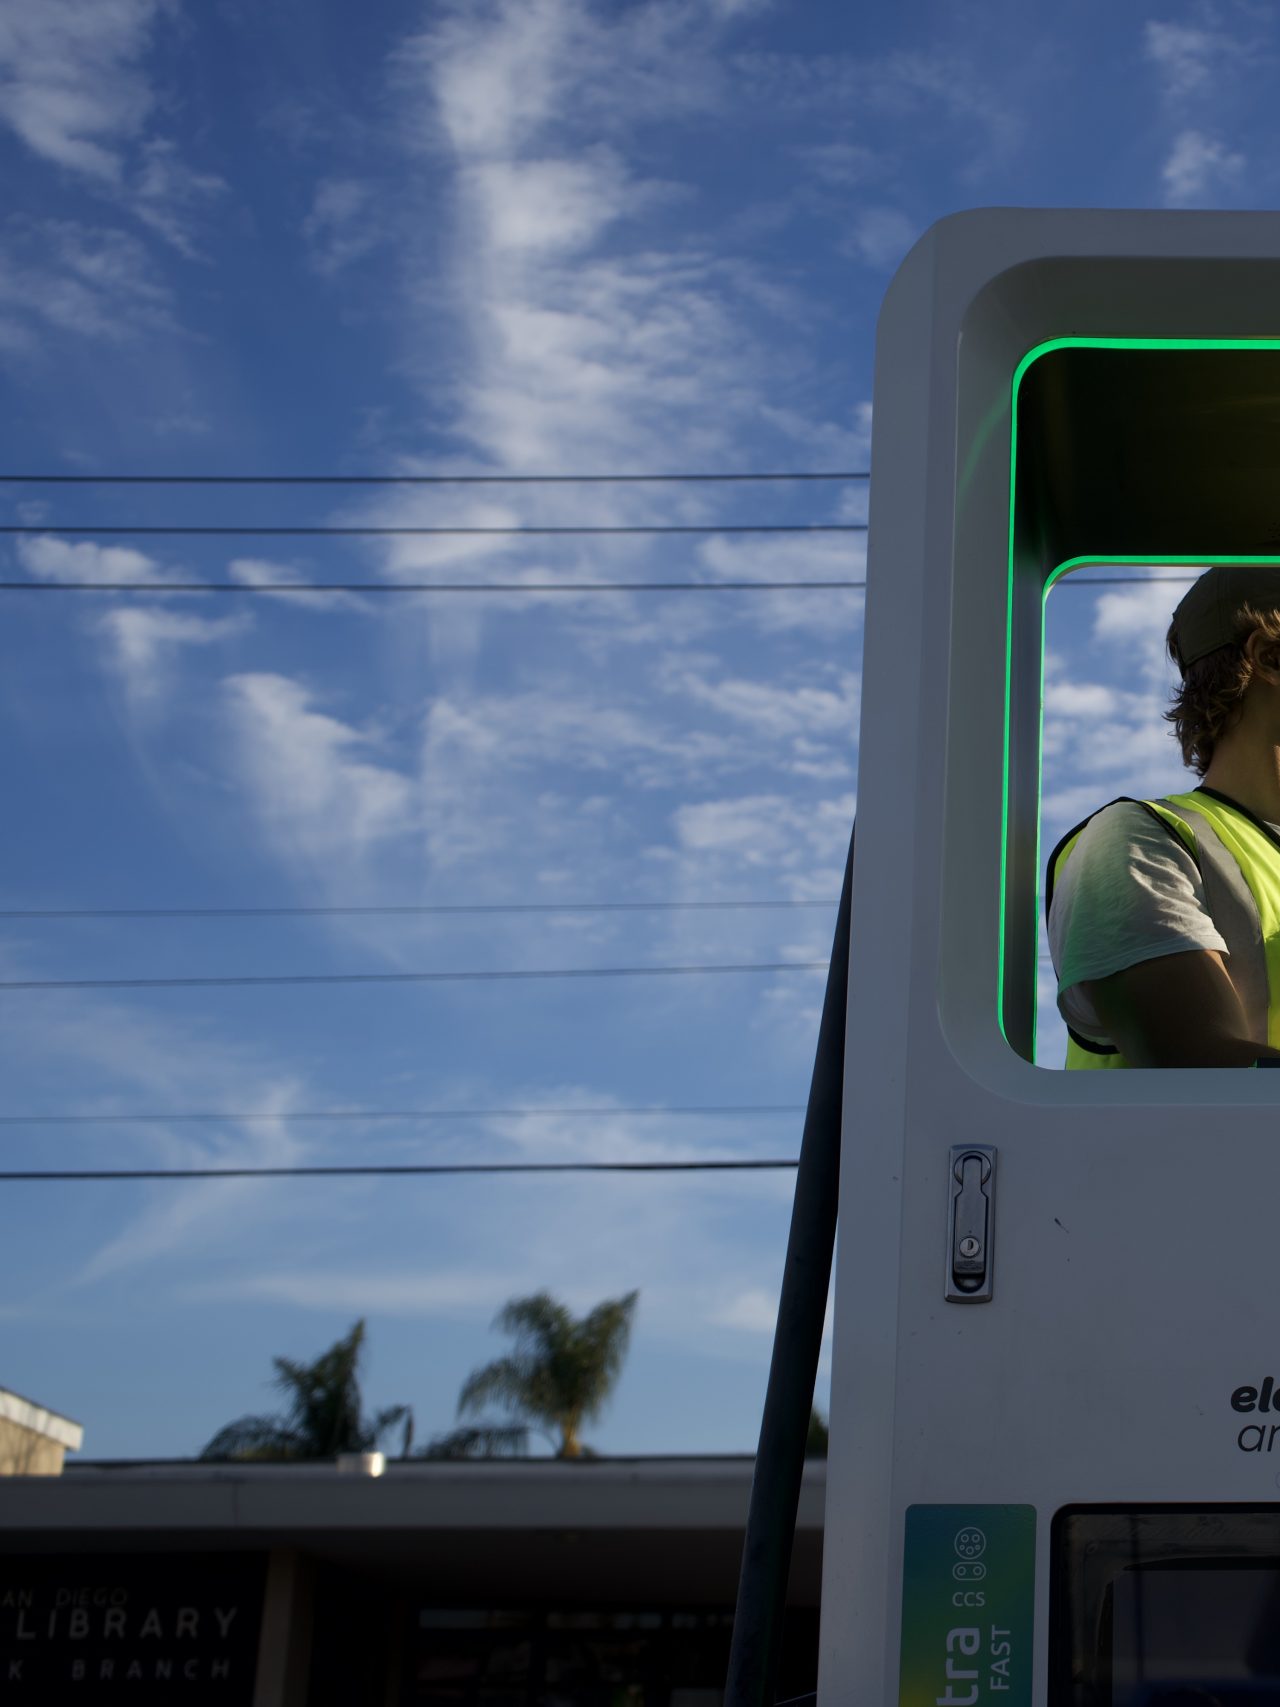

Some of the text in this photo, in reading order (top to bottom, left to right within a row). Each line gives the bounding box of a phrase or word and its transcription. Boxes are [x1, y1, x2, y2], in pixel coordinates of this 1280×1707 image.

[55, 1585, 129, 1608] DIEGO
[952, 1591, 986, 1607] CCS
[15, 1604, 239, 1641] LIBRARY
[70, 1657, 231, 1681] BRANCH
[990, 1624, 1012, 1690] FAST
